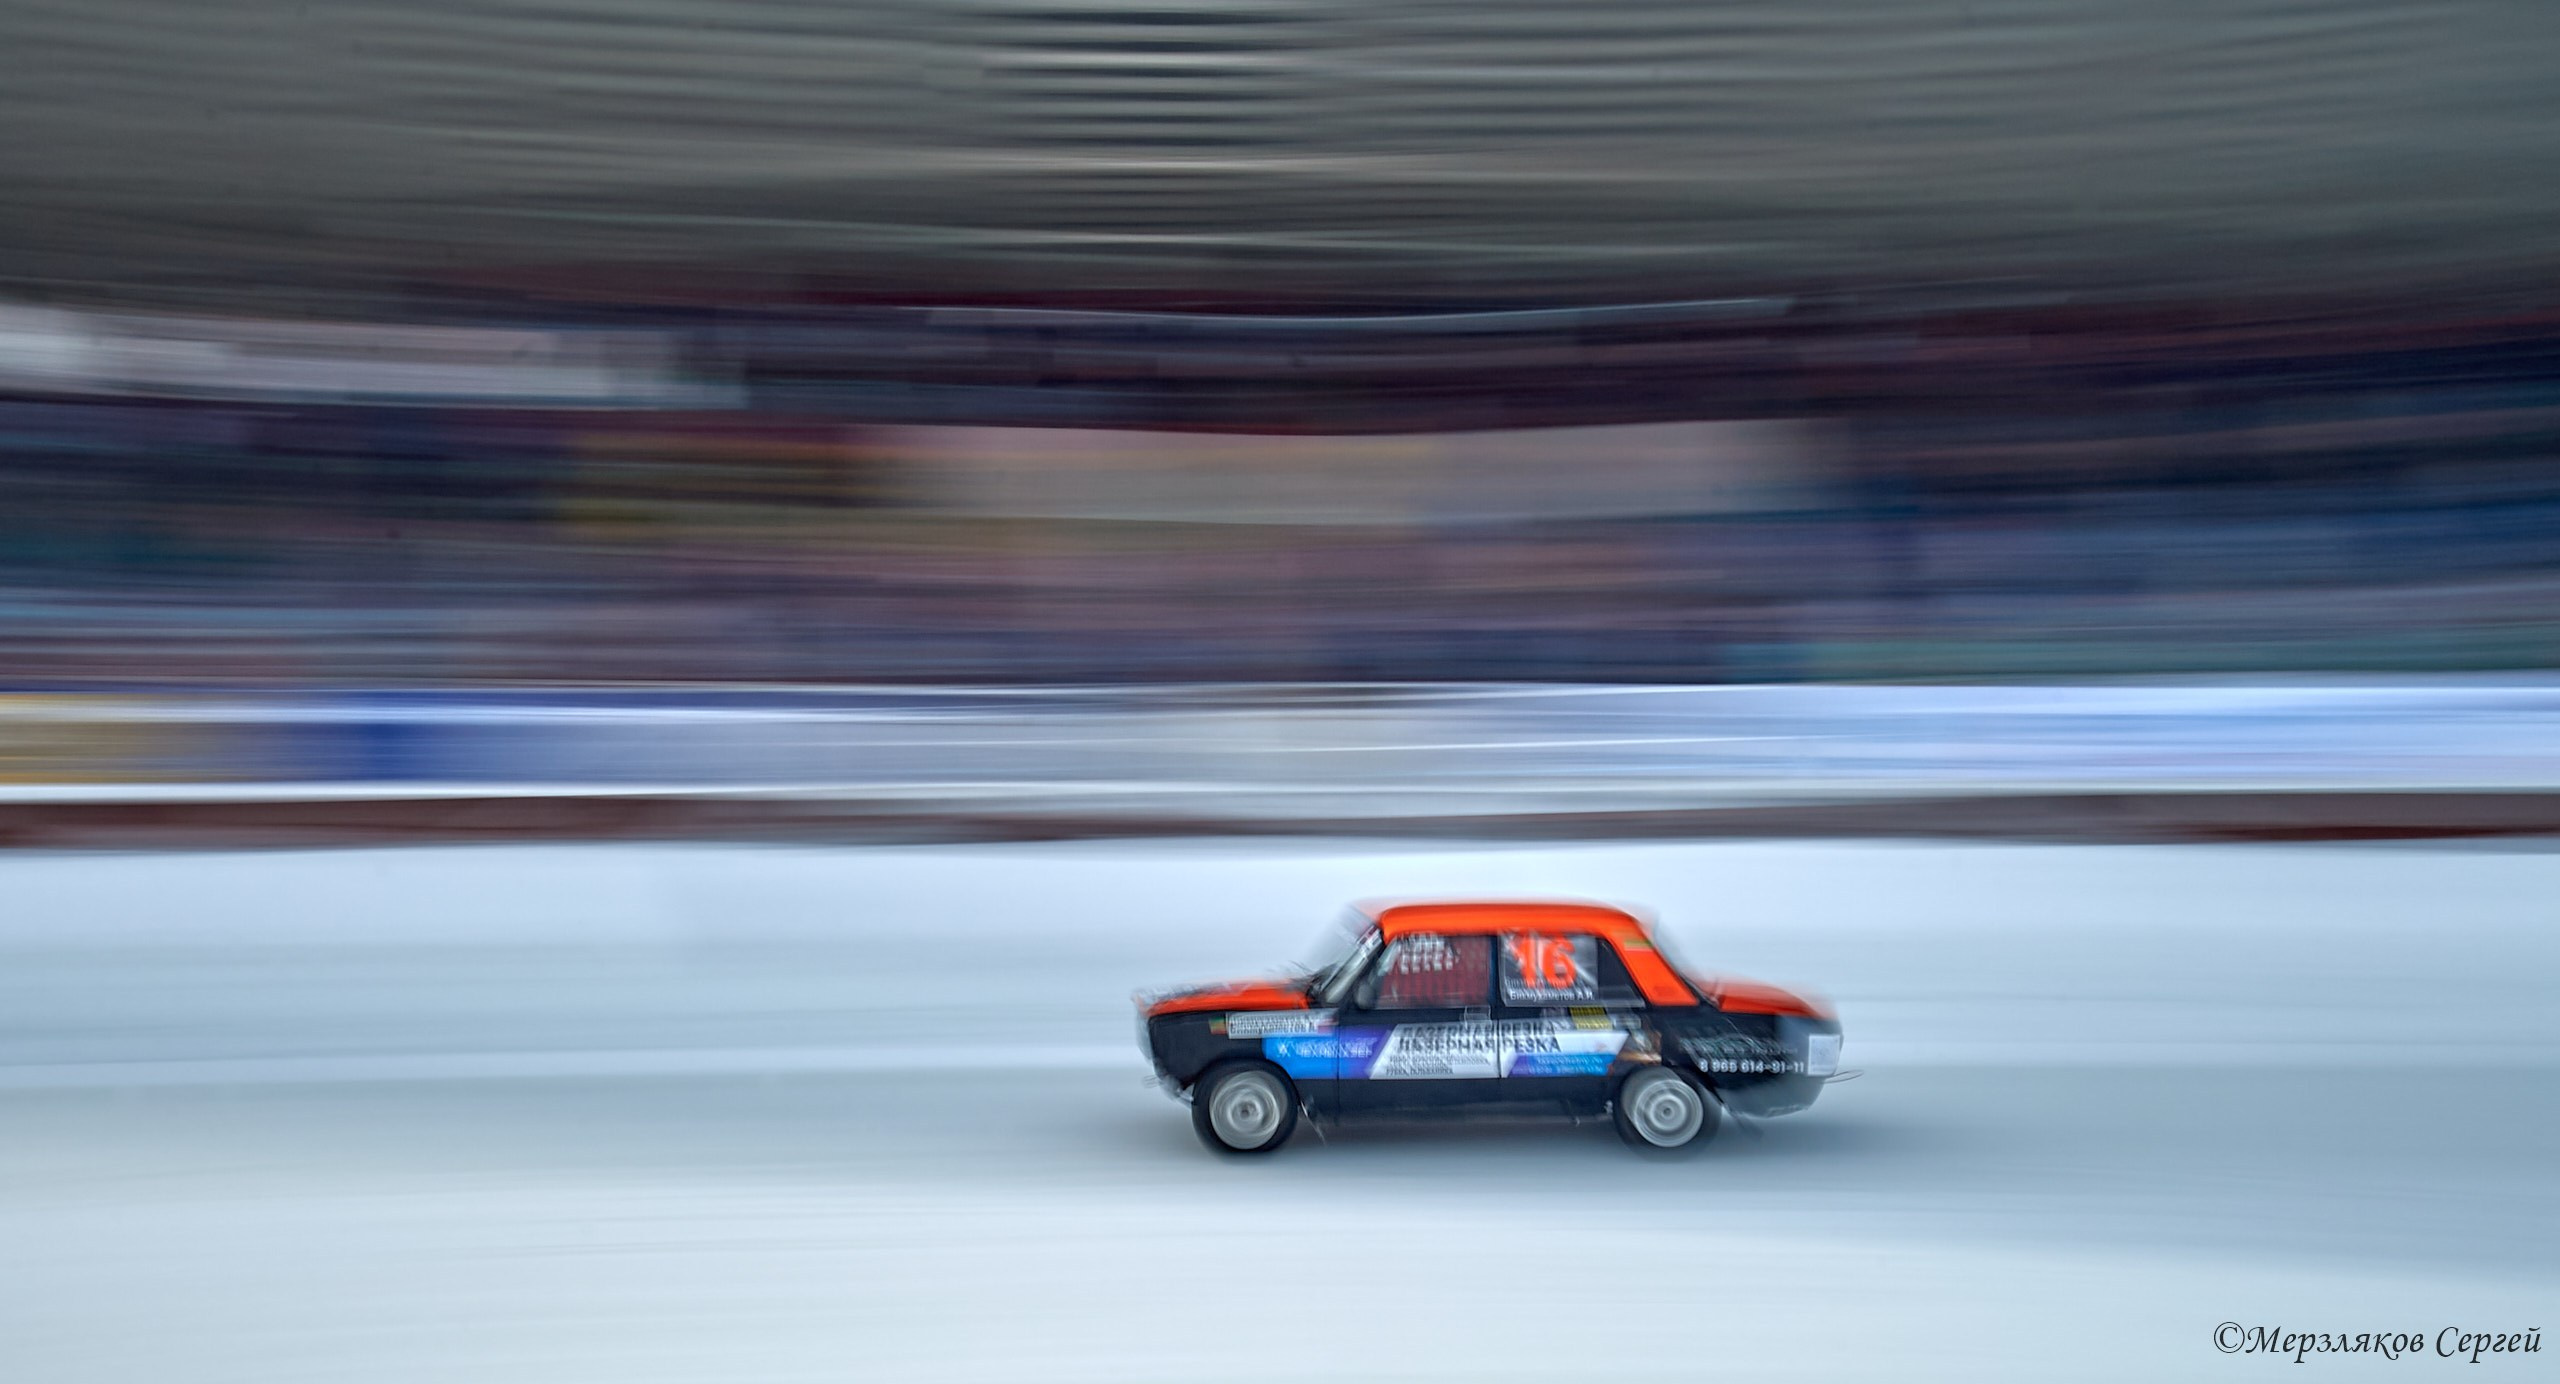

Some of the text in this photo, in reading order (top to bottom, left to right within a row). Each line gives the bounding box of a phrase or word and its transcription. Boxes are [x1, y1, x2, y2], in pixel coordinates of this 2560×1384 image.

[1511, 934, 1577, 989] 16
[1400, 1031, 1496, 1053] ЛАЗЕРНАЯ
[1500, 1031, 1561, 1053] РЕЗКА
